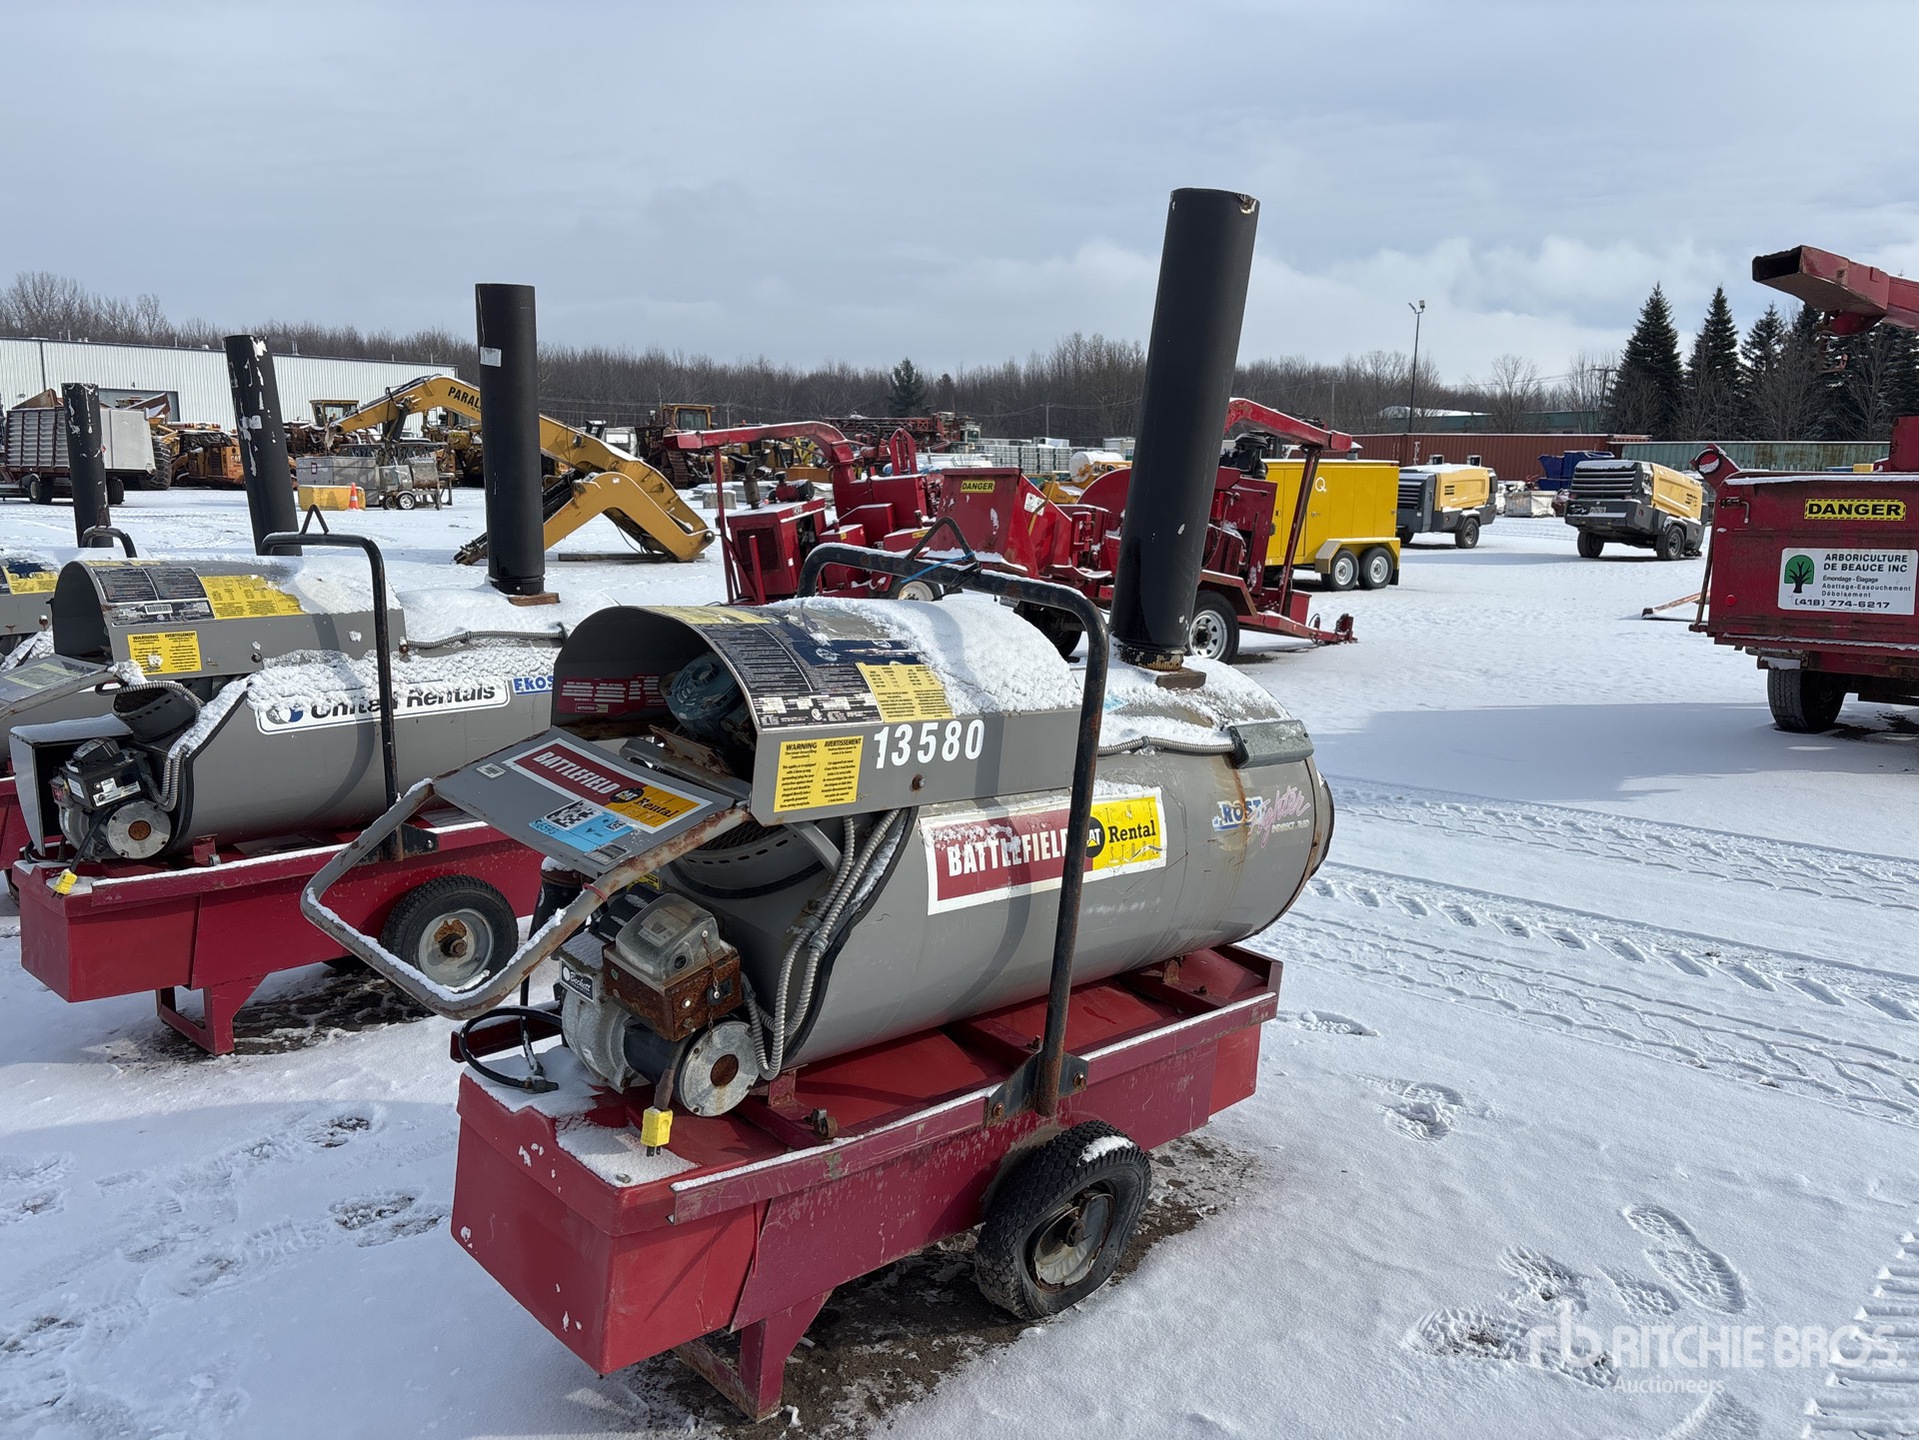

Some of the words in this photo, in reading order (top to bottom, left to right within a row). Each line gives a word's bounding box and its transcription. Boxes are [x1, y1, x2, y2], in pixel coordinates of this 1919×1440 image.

[447, 386, 482, 410] PARAL
[961, 482, 994, 491] DANGER
[1807, 503, 1901, 516] DANGER
[1824, 553, 1908, 563] ARBORICULTURE
[1823, 563, 1837, 571] DE
[1841, 563, 1884, 572] BEAUCE
[1888, 564, 1908, 573] INC
[1794, 598, 1826, 607] (418)
[1829, 599, 1891, 609] 774-6217
[785, 741, 818, 751] WARNING
[823, 738, 862, 748] AVERTISSEMENT
[873, 719, 985, 770] 13580
[532, 751, 621, 795] BATTLEFIELD
[635, 797, 680, 818] Rental
[1212, 796, 1263, 832] ROST
[1108, 820, 1157, 843] Rental
